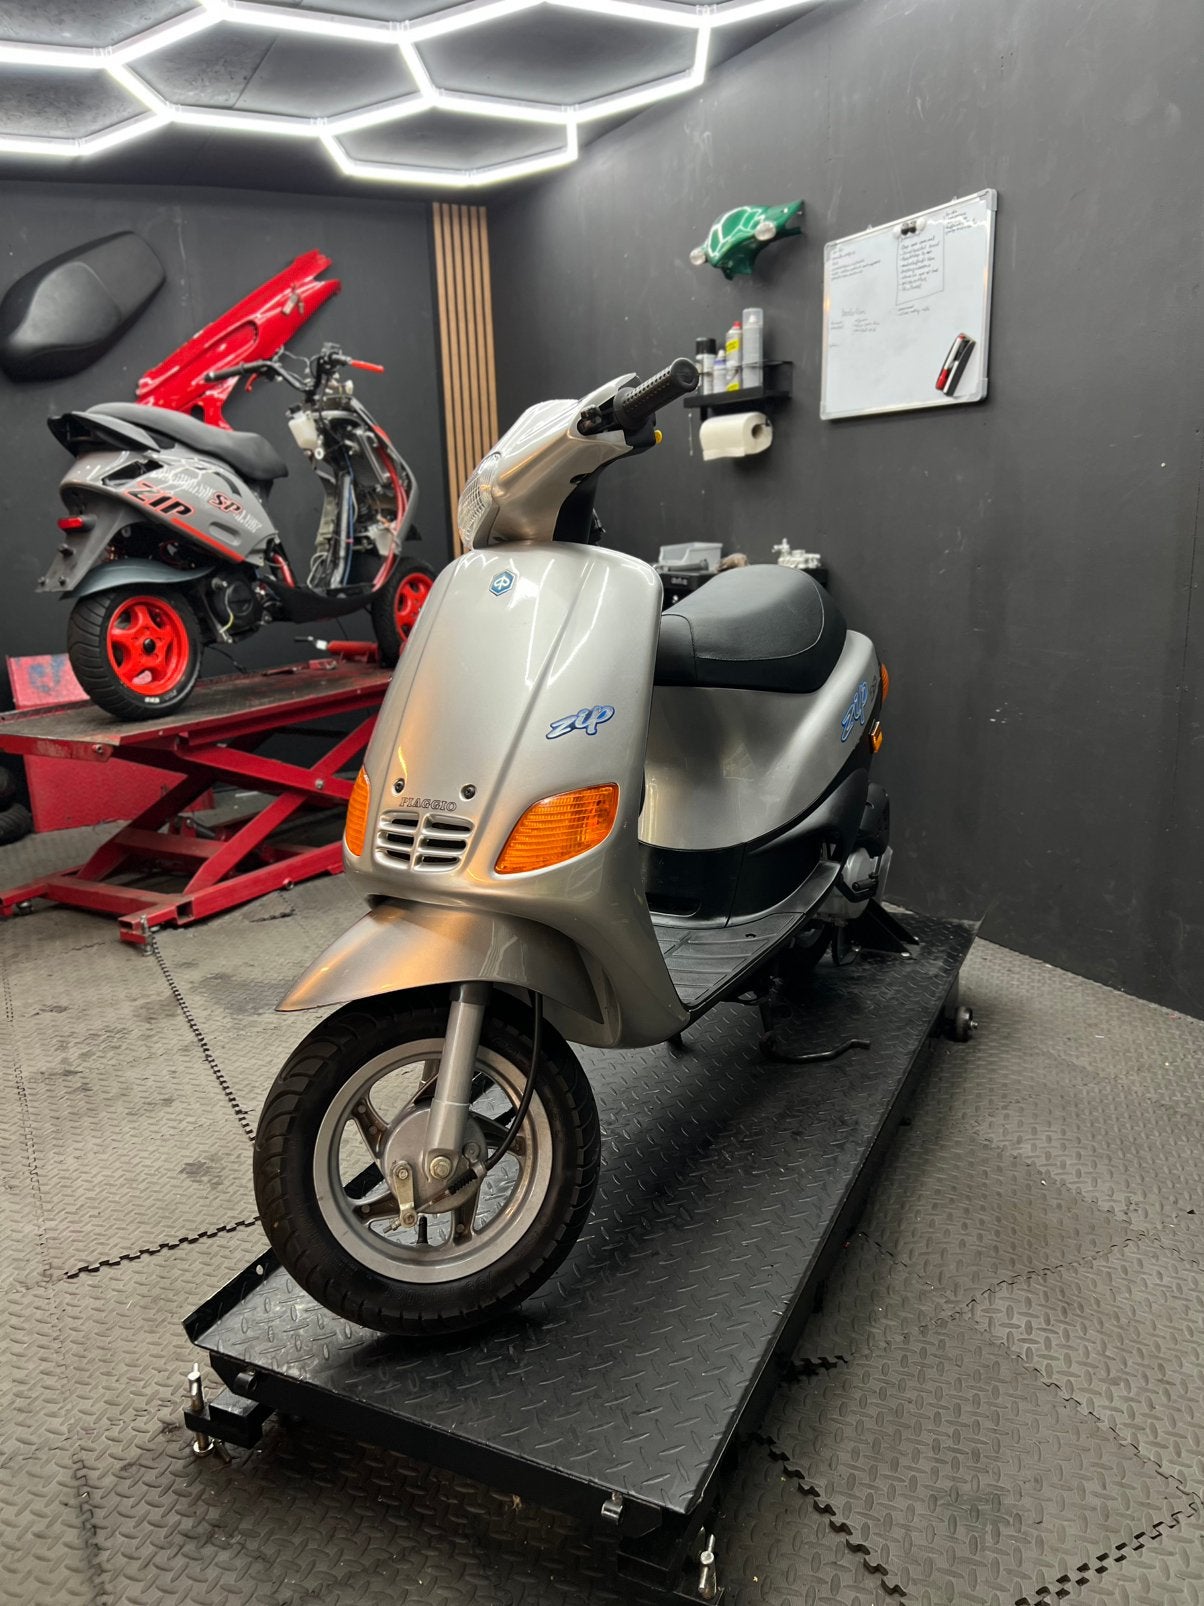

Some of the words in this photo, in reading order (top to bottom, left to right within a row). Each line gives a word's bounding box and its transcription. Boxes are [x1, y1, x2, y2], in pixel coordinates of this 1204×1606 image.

[122, 480, 196, 517] ZIP
[208, 491, 242, 514] SP
[399, 797, 457, 812] PIAGGIO
